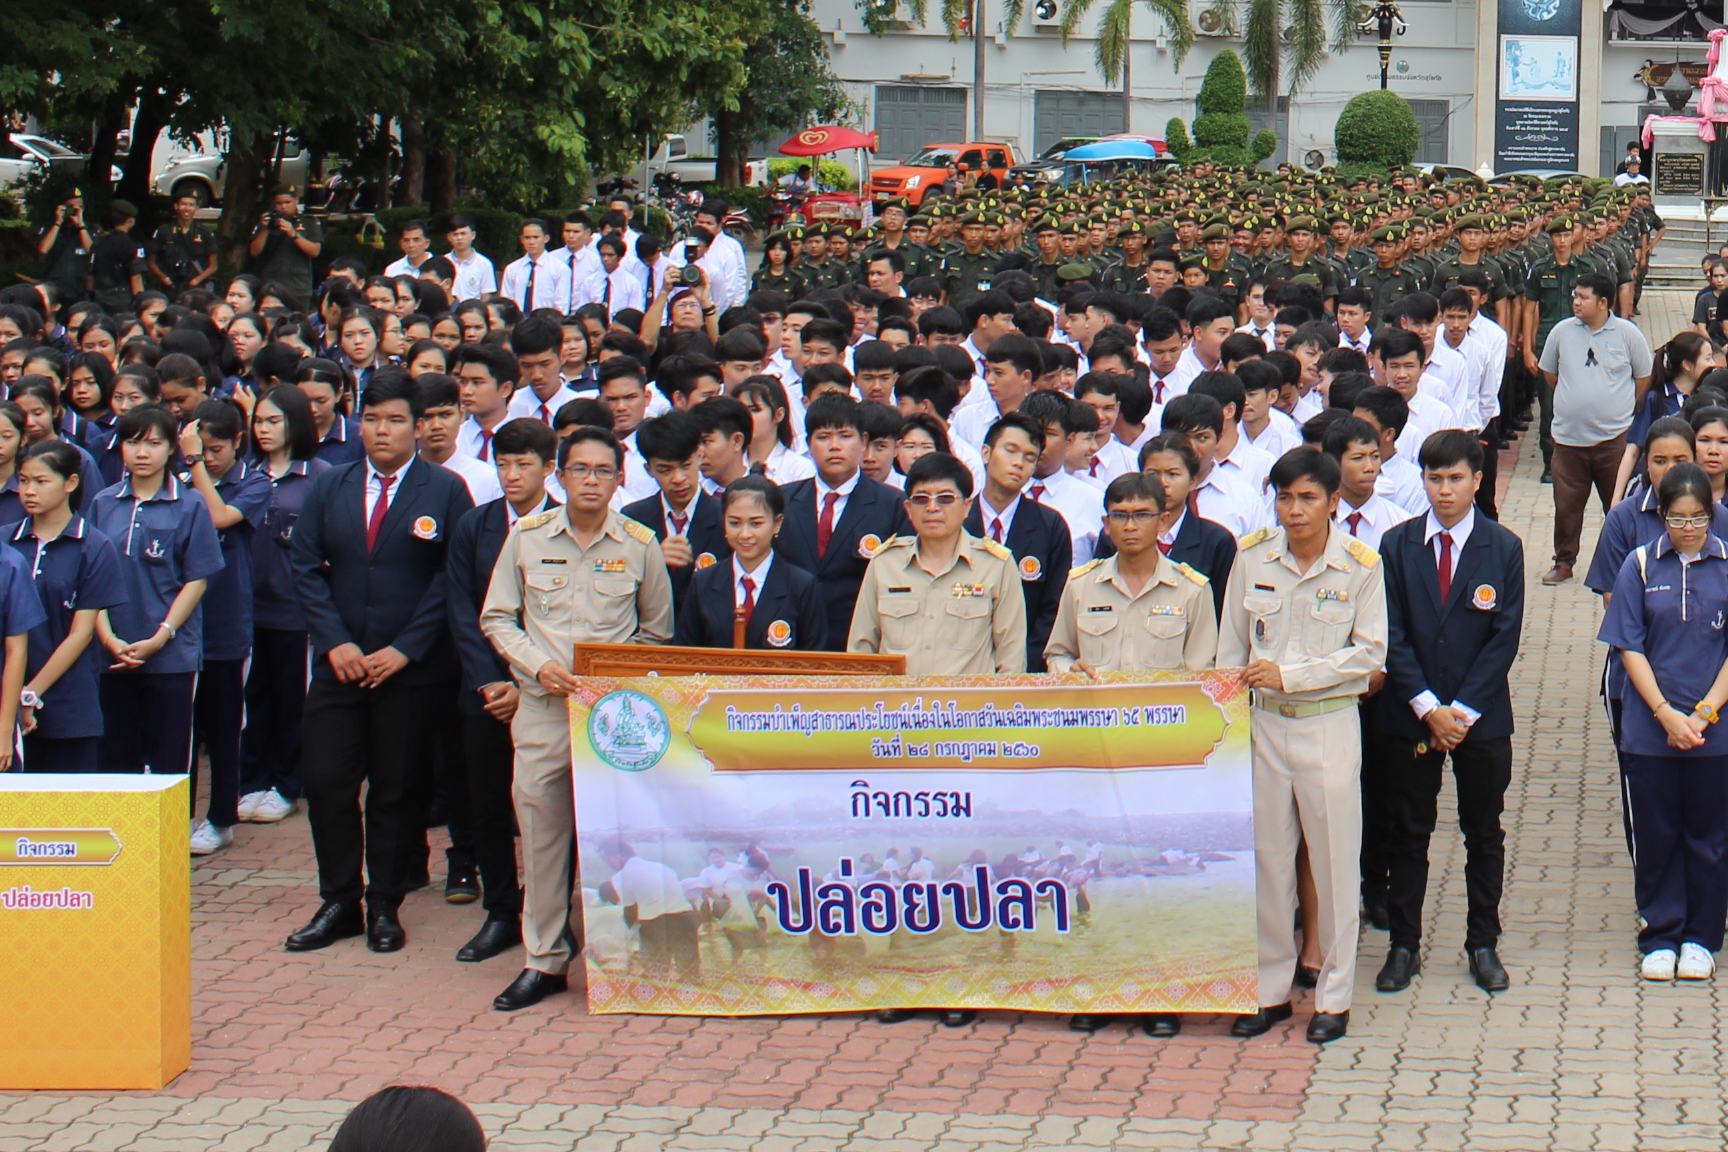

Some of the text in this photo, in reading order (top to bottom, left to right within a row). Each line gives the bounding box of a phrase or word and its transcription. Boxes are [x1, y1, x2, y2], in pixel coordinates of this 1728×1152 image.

[1123, 707, 1141, 725] ๖๕
[1145, 704, 1186, 724] พรรษา
[872, 734, 1040, 761] วันที่ ๒๘ กรกฎาคม ๒๕๖๐
[850, 779, 972, 819] กิจกรรม
[17, 838, 76, 857] กิจกรรม
[2, 886, 93, 909] ปล่อยปลา
[767, 857, 1071, 935] ปล่อยปลา
